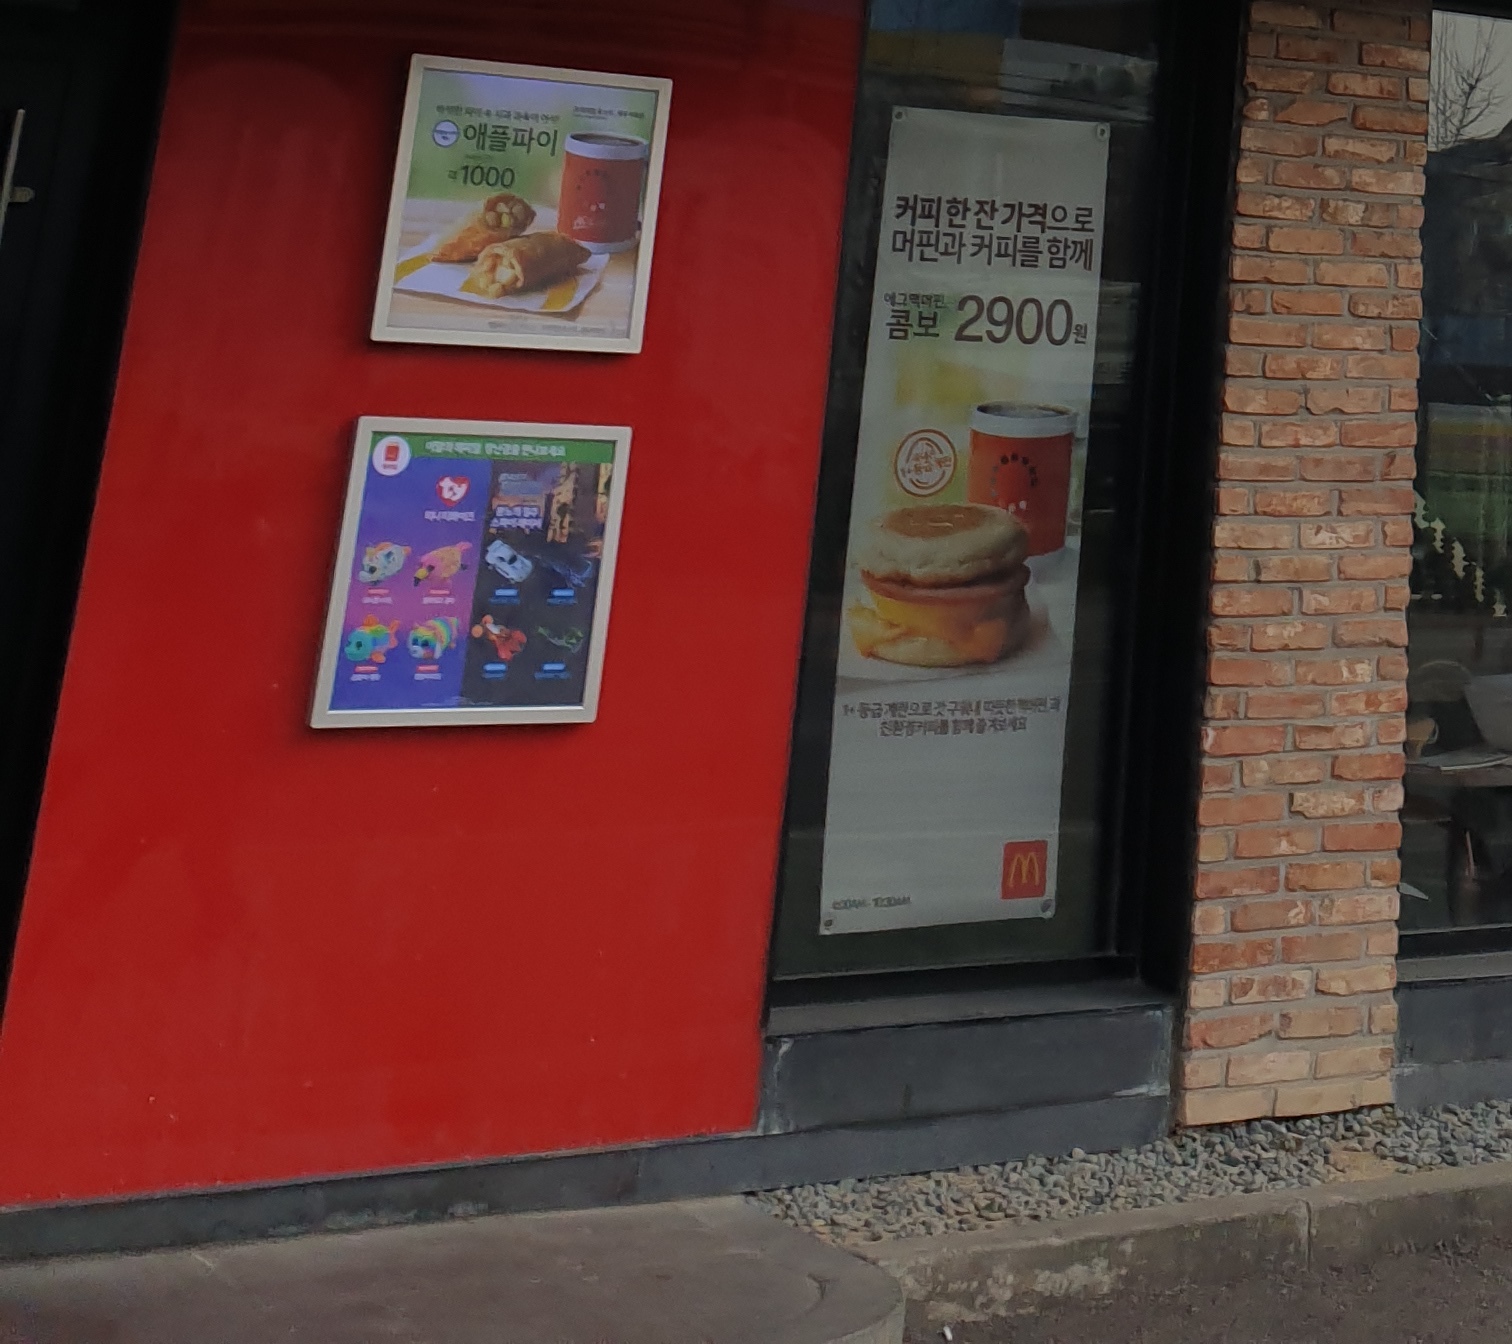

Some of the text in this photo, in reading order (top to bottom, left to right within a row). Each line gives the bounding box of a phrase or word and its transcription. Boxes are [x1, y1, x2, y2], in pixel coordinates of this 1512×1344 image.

[463, 122, 558, 156] 애플파이
[461, 165, 516, 188] 1000
[895, 194, 942, 228] 커피
[1001, 202, 1095, 234] 가격으로
[892, 229, 1094, 271] 머핀과 커피를 함께
[886, 309, 939, 341] 콤보
[438, 476, 469, 501] ty
